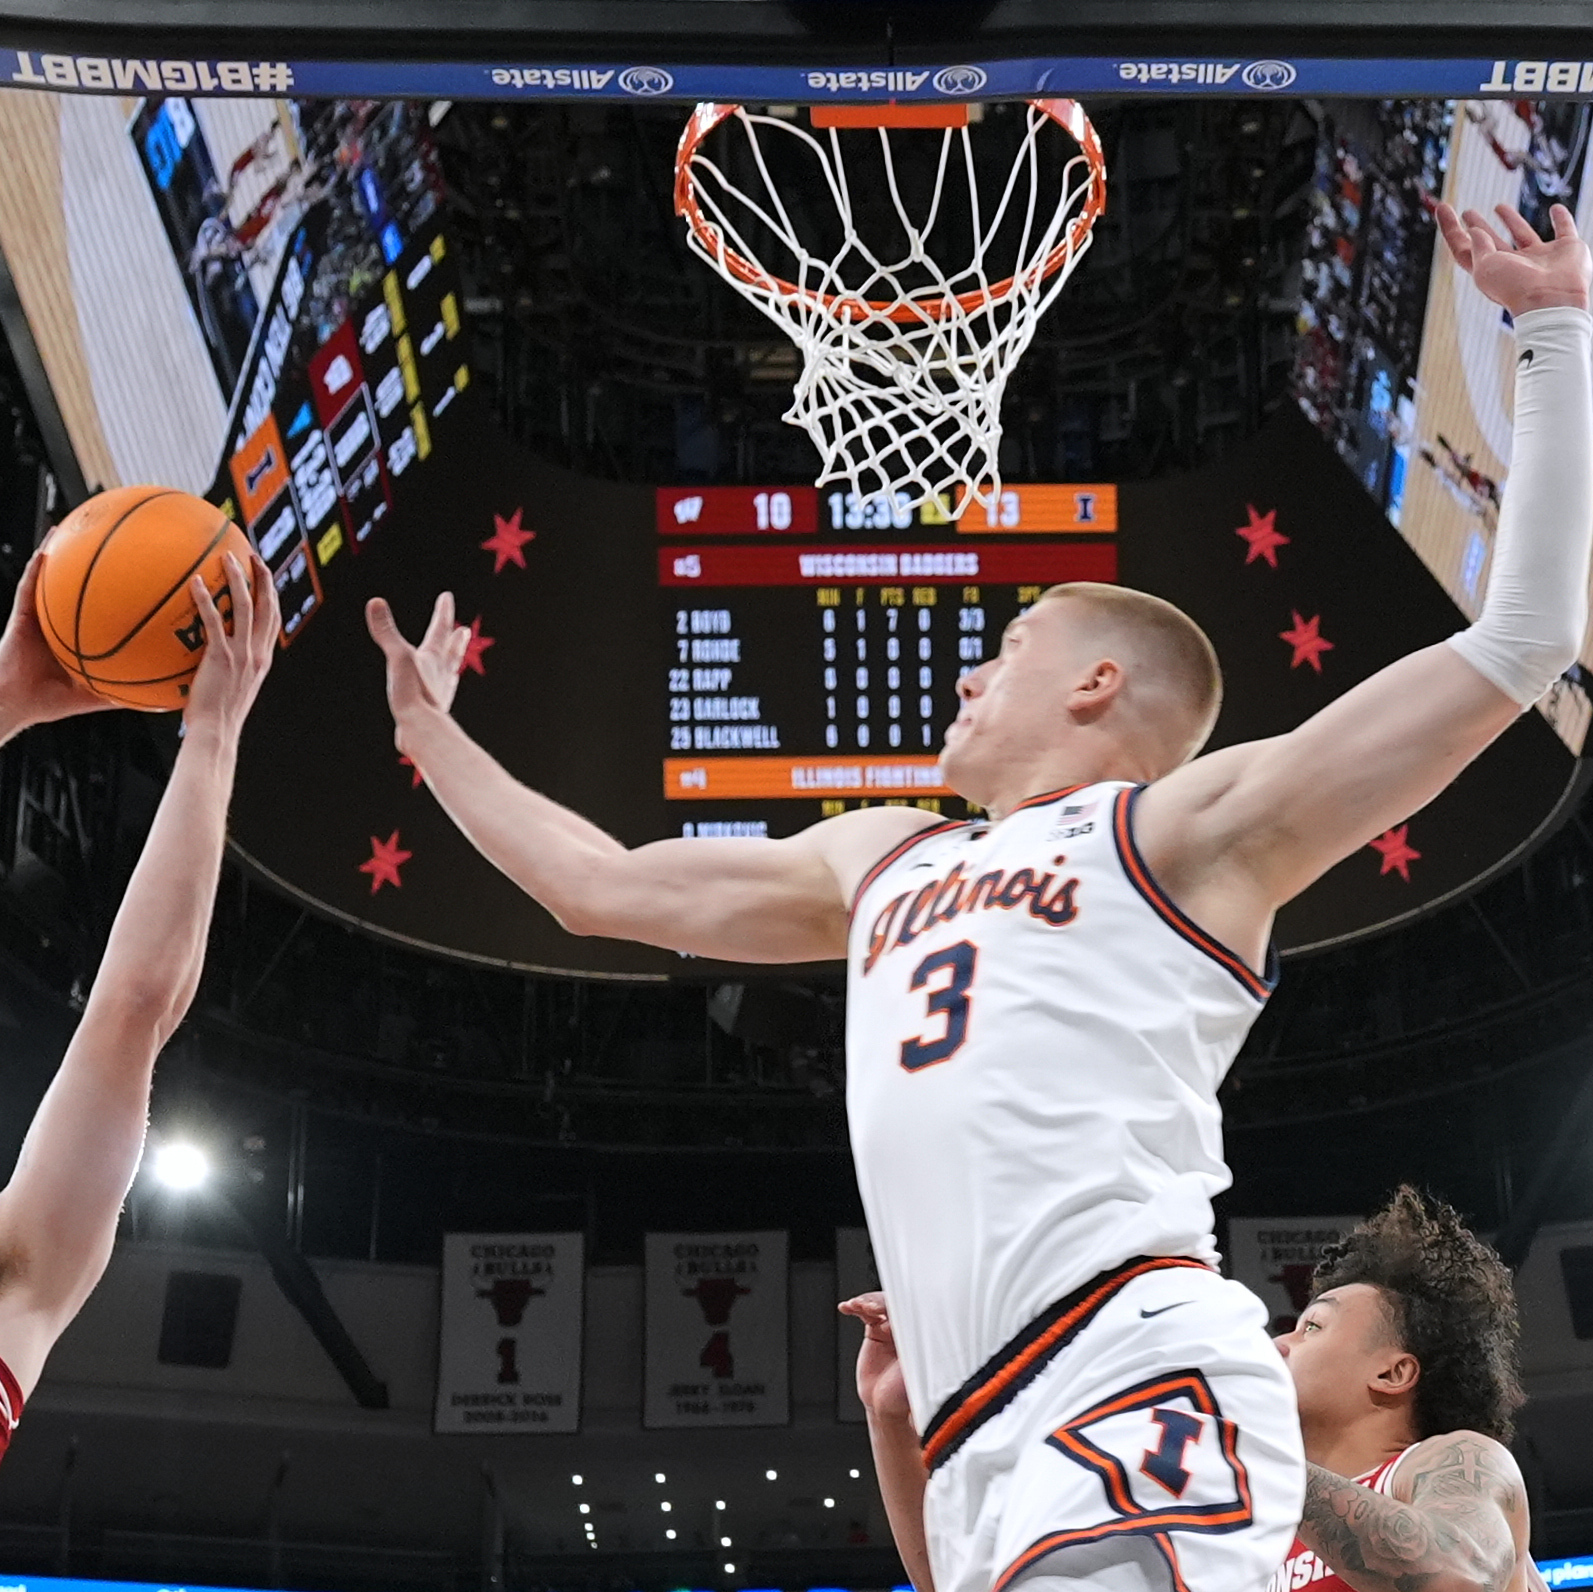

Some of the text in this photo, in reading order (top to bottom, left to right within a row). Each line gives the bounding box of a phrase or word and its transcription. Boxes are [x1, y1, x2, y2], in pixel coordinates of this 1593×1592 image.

[491, 68, 615, 91] Allstate
[809, 69, 929, 92] Allstate
[1119, 63, 1241, 85] Allstate
[754, 492, 792, 530] 10
[799, 553, 898, 576] WISCONSIN
[676, 610, 689, 634] 2
[668, 668, 690, 692] 22
[863, 855, 1081, 977] Illinois
[899, 939, 978, 1074] 3
[1138, 1407, 1204, 1499] I
